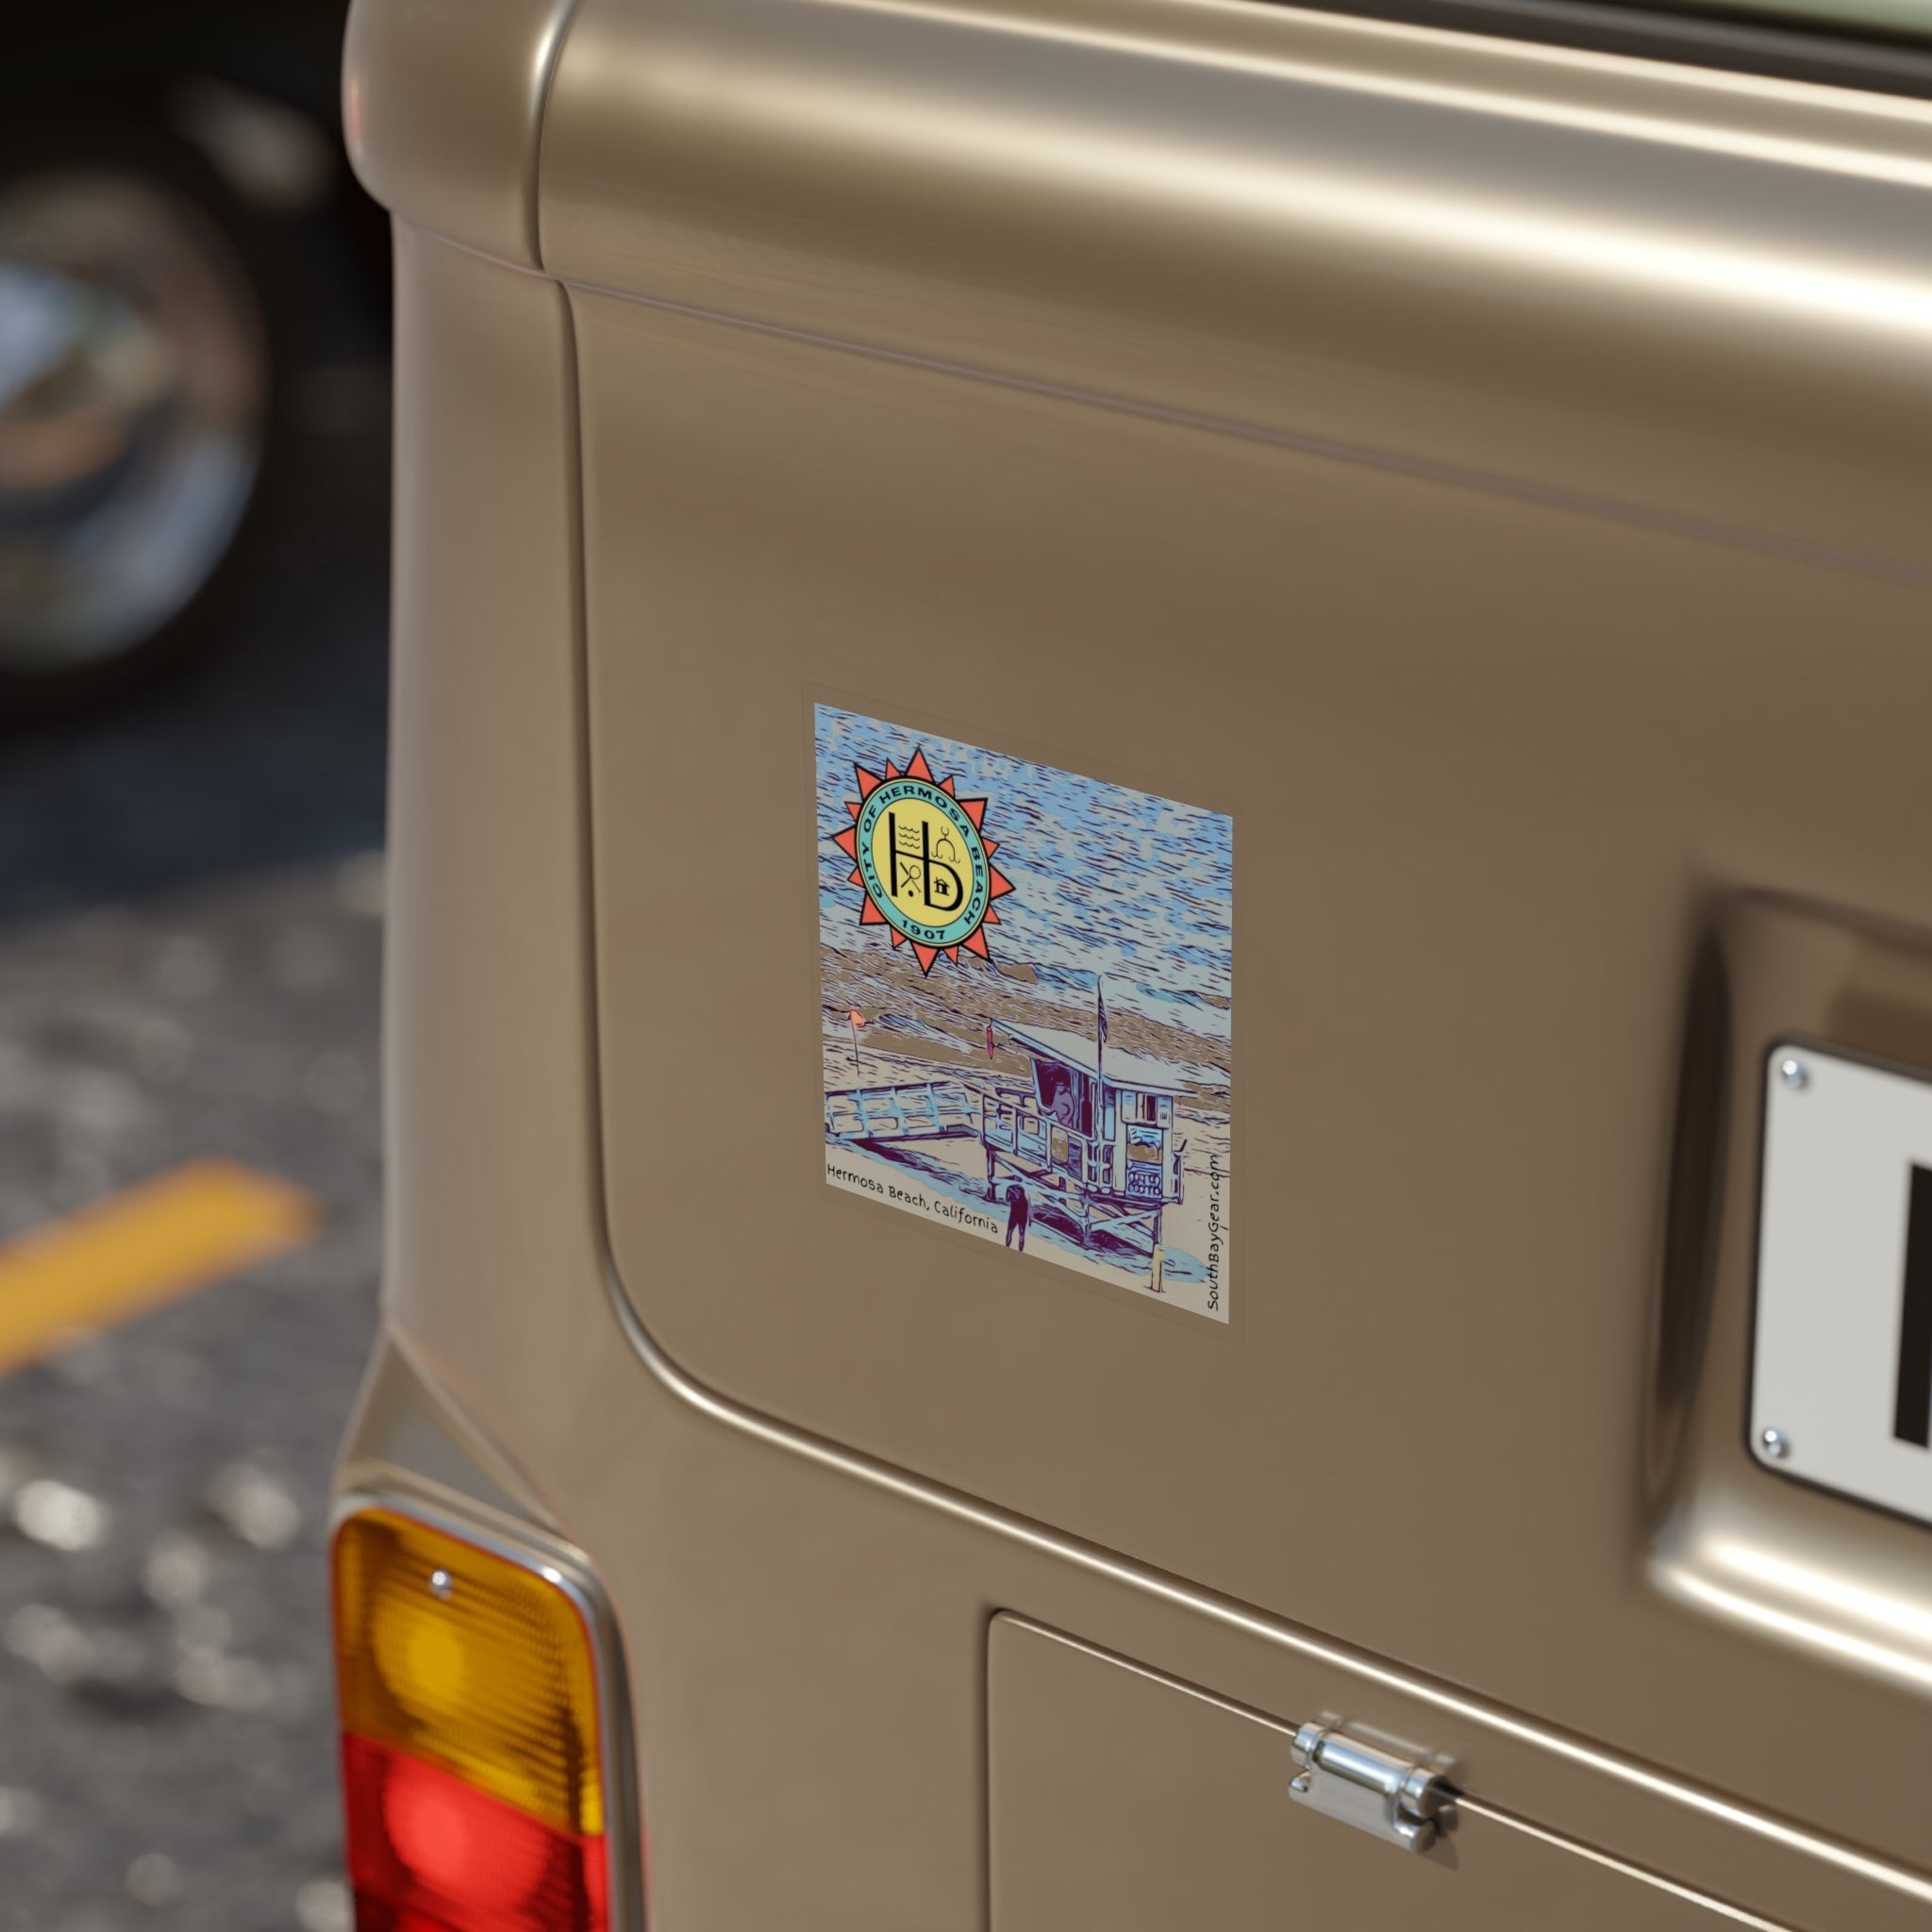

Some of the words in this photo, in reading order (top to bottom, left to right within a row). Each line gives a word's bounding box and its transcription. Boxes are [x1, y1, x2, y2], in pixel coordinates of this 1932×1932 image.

[863, 807, 878, 834] OF
[879, 785, 971, 838] HERMOSA
[862, 841, 883, 898] CITY
[963, 846, 984, 925] BEACH
[901, 919, 947, 941] 1907
[826, 1163, 885, 1194] Hermosa
[888, 1185, 930, 1211] Beach,
[934, 1200, 999, 1234] California
[1207, 1154, 1224, 1312] SouthBayGear.com
